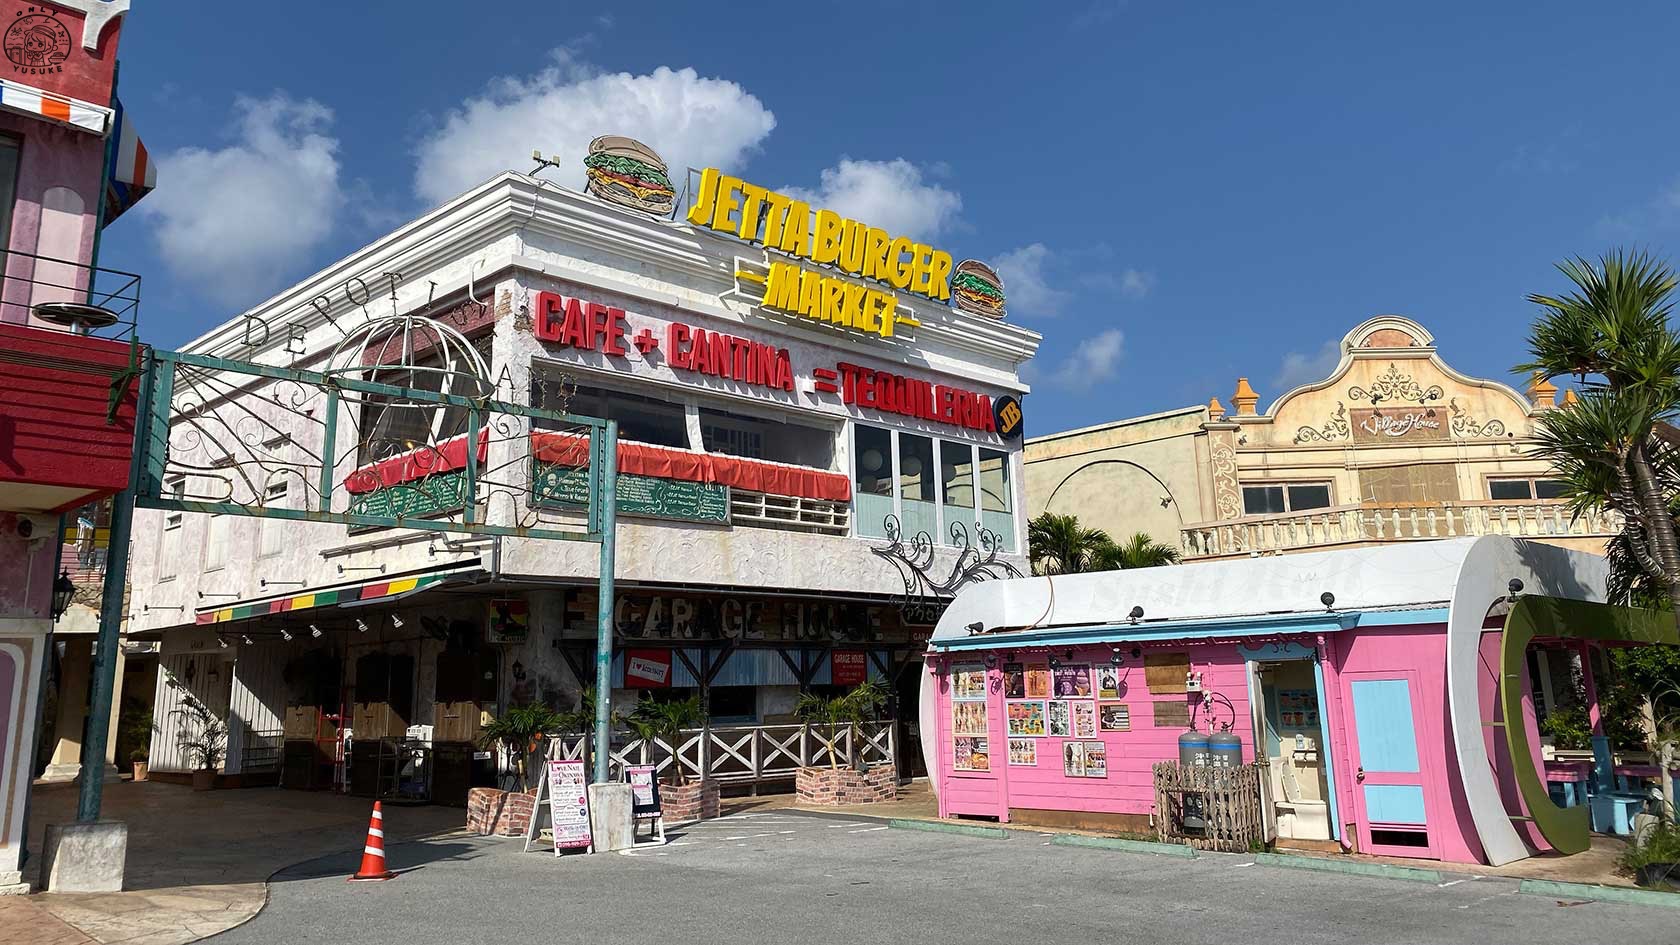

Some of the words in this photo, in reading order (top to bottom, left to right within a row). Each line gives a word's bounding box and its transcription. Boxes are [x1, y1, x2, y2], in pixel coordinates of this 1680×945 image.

[687, 167, 810, 258] JETTA
[812, 209, 953, 301] BURGER
[240, 271, 403, 355] DEPOT
[761, 262, 899, 338] MARKET
[534, 290, 626, 357] CAFE
[667, 323, 795, 392] CANTINA
[837, 362, 998, 434] TEQUILERIA
[1000, 401, 1021, 433] JB
[614, 595, 765, 640] GARAGE
